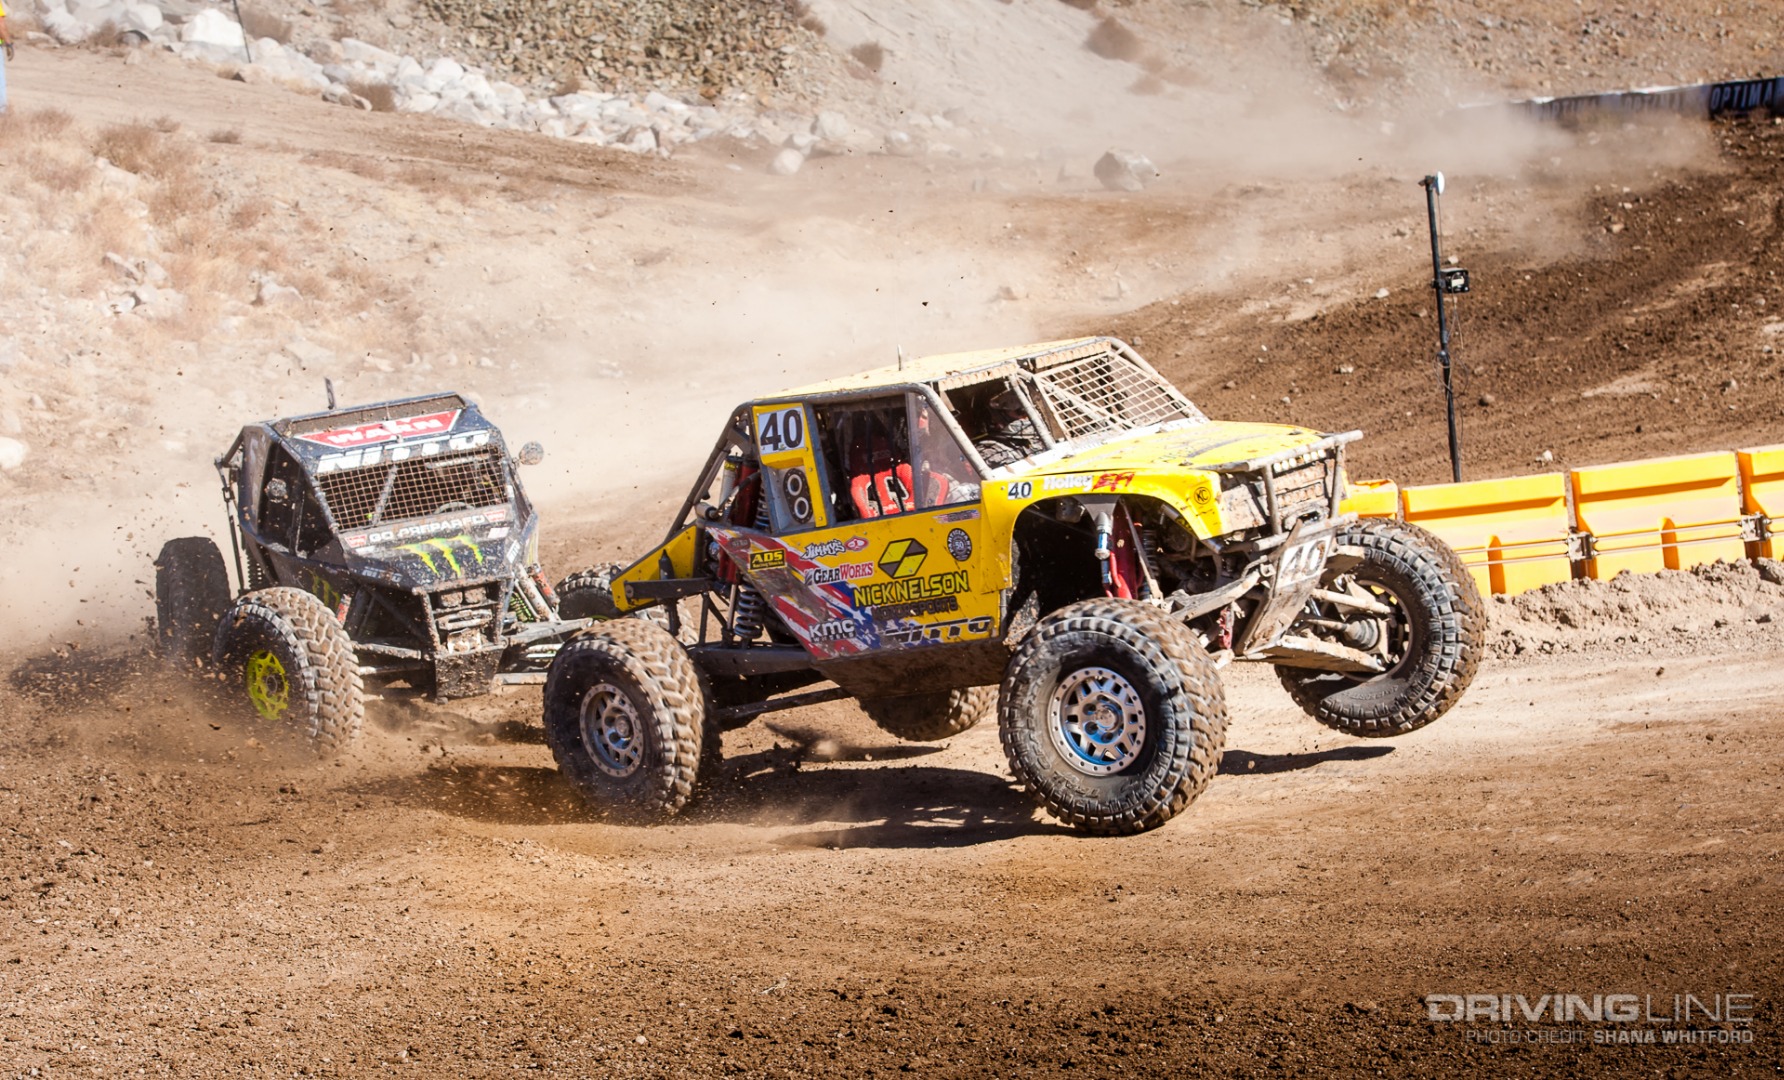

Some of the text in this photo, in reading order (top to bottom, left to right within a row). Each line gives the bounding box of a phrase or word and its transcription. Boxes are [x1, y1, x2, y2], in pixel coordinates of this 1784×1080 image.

[1711, 81, 1774, 110] OPTIMA
[327, 418, 443, 444] WARN
[760, 409, 803, 451] 40
[316, 430, 491, 474] NITTO
[1007, 481, 1032, 499] 40
[1043, 475, 1093, 492] Holley
[368, 531, 394, 543] GO
[752, 551, 783, 563] ADS
[1280, 539, 1326, 581] 40
[813, 562, 874, 584] GEARWORKS
[884, 616, 992, 644] NITTO
